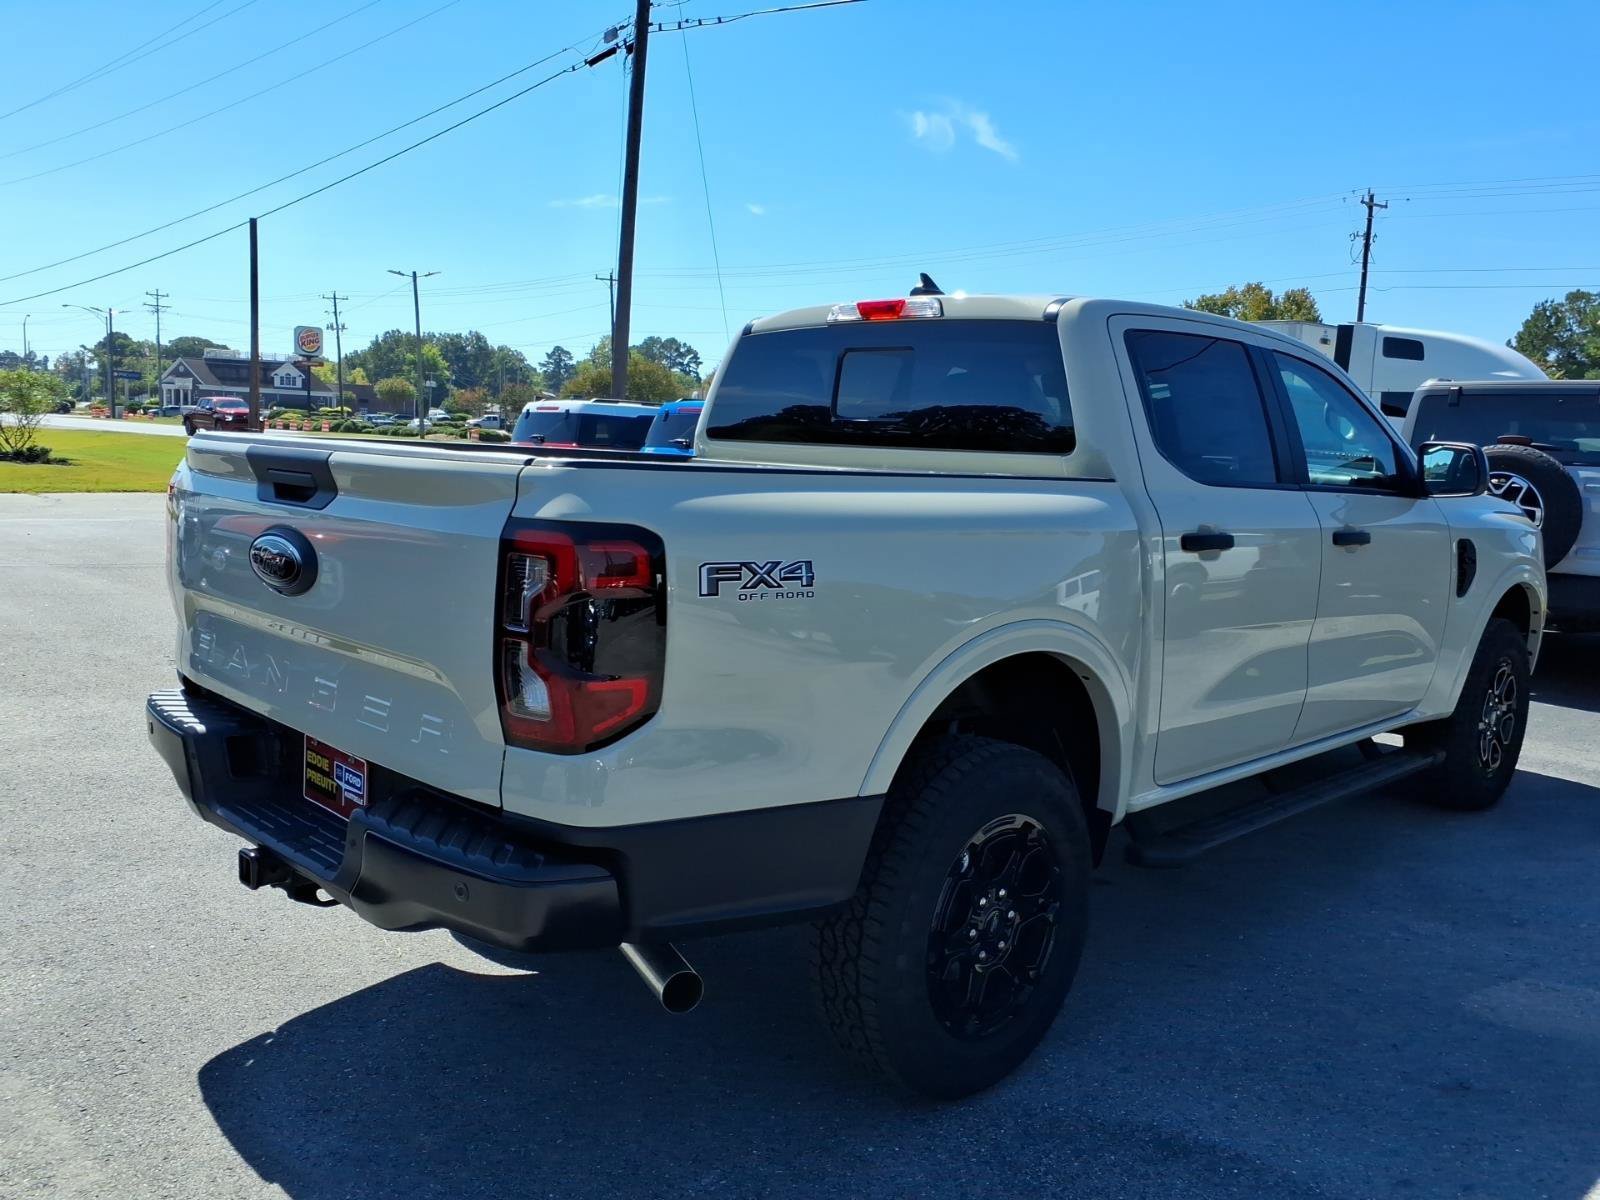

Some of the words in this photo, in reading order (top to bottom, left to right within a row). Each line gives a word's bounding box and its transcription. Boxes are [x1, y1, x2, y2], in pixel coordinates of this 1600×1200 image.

[301, 337, 320, 347] KING
[698, 559, 815, 597] FX4
[738, 592, 769, 601] OFF
[775, 591, 815, 599] ROAD
[306, 750, 330, 772] EDDIE
[345, 772, 362, 788] FORD
